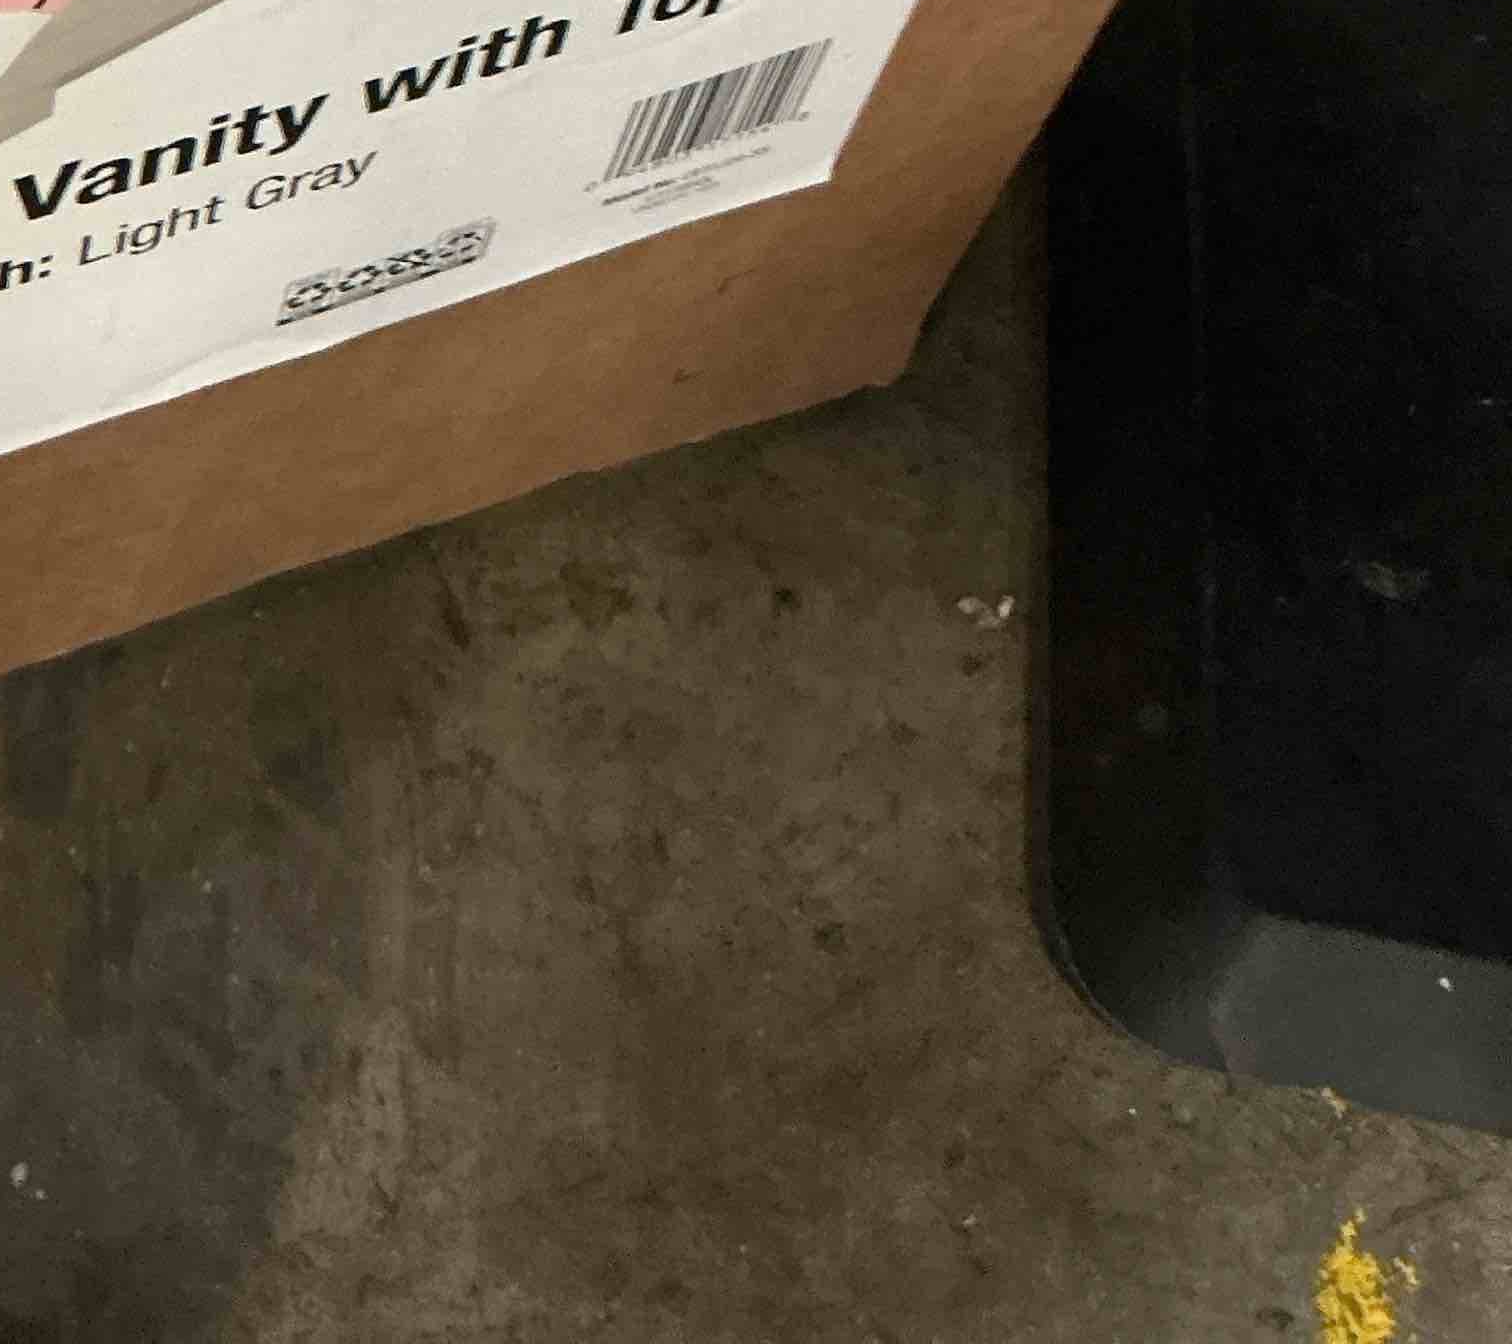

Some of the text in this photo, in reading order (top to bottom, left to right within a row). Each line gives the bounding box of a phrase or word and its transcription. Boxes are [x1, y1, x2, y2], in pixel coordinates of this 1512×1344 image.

[12, 93, 328, 221] Vanity
[361, 14, 571, 114] with
[77, 195, 225, 267] Light
[245, 149, 379, 213] Gray
